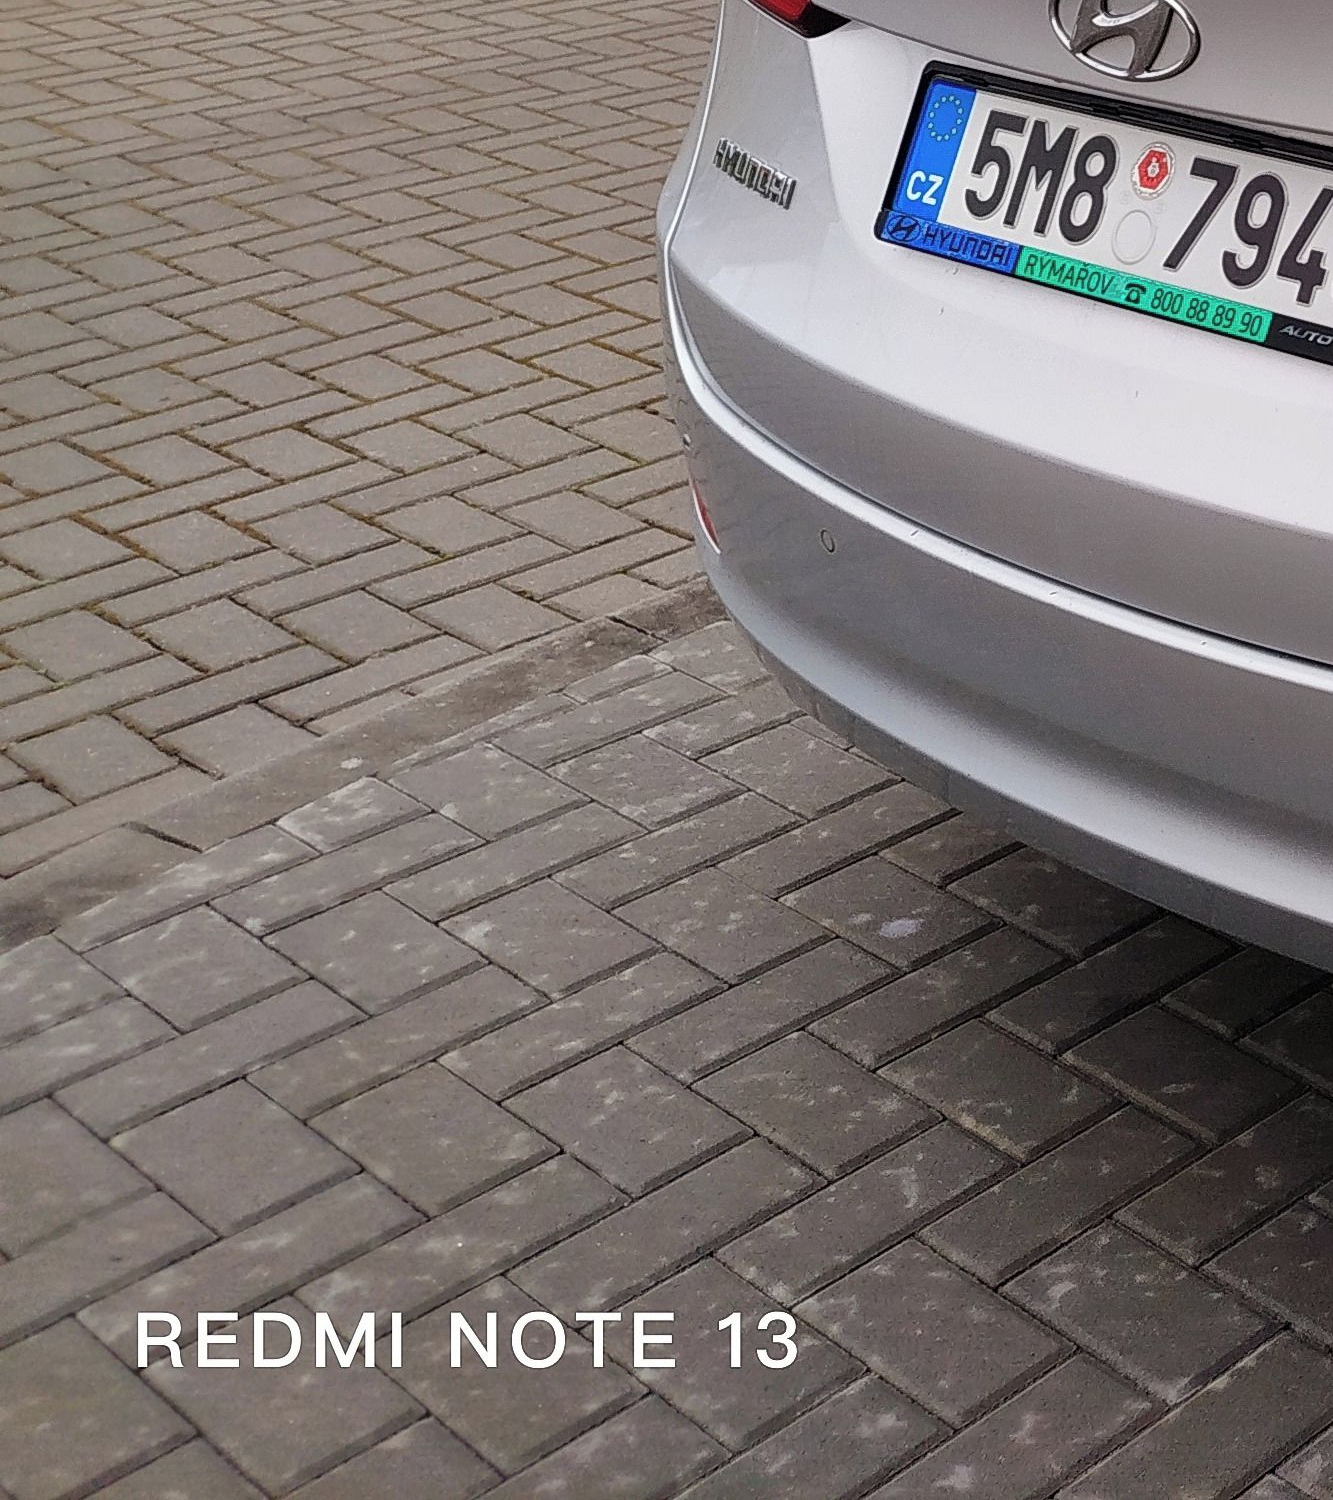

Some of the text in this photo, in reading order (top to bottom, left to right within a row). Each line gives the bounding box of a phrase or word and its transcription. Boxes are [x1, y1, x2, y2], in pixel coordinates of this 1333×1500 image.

[906, 170, 944, 206] CZ
[965, 109, 1118, 244] 5M8
[923, 223, 1014, 267] HYUNDAI
[1024, 253, 1263, 337] RYMAŘOV 800 88 89 90
